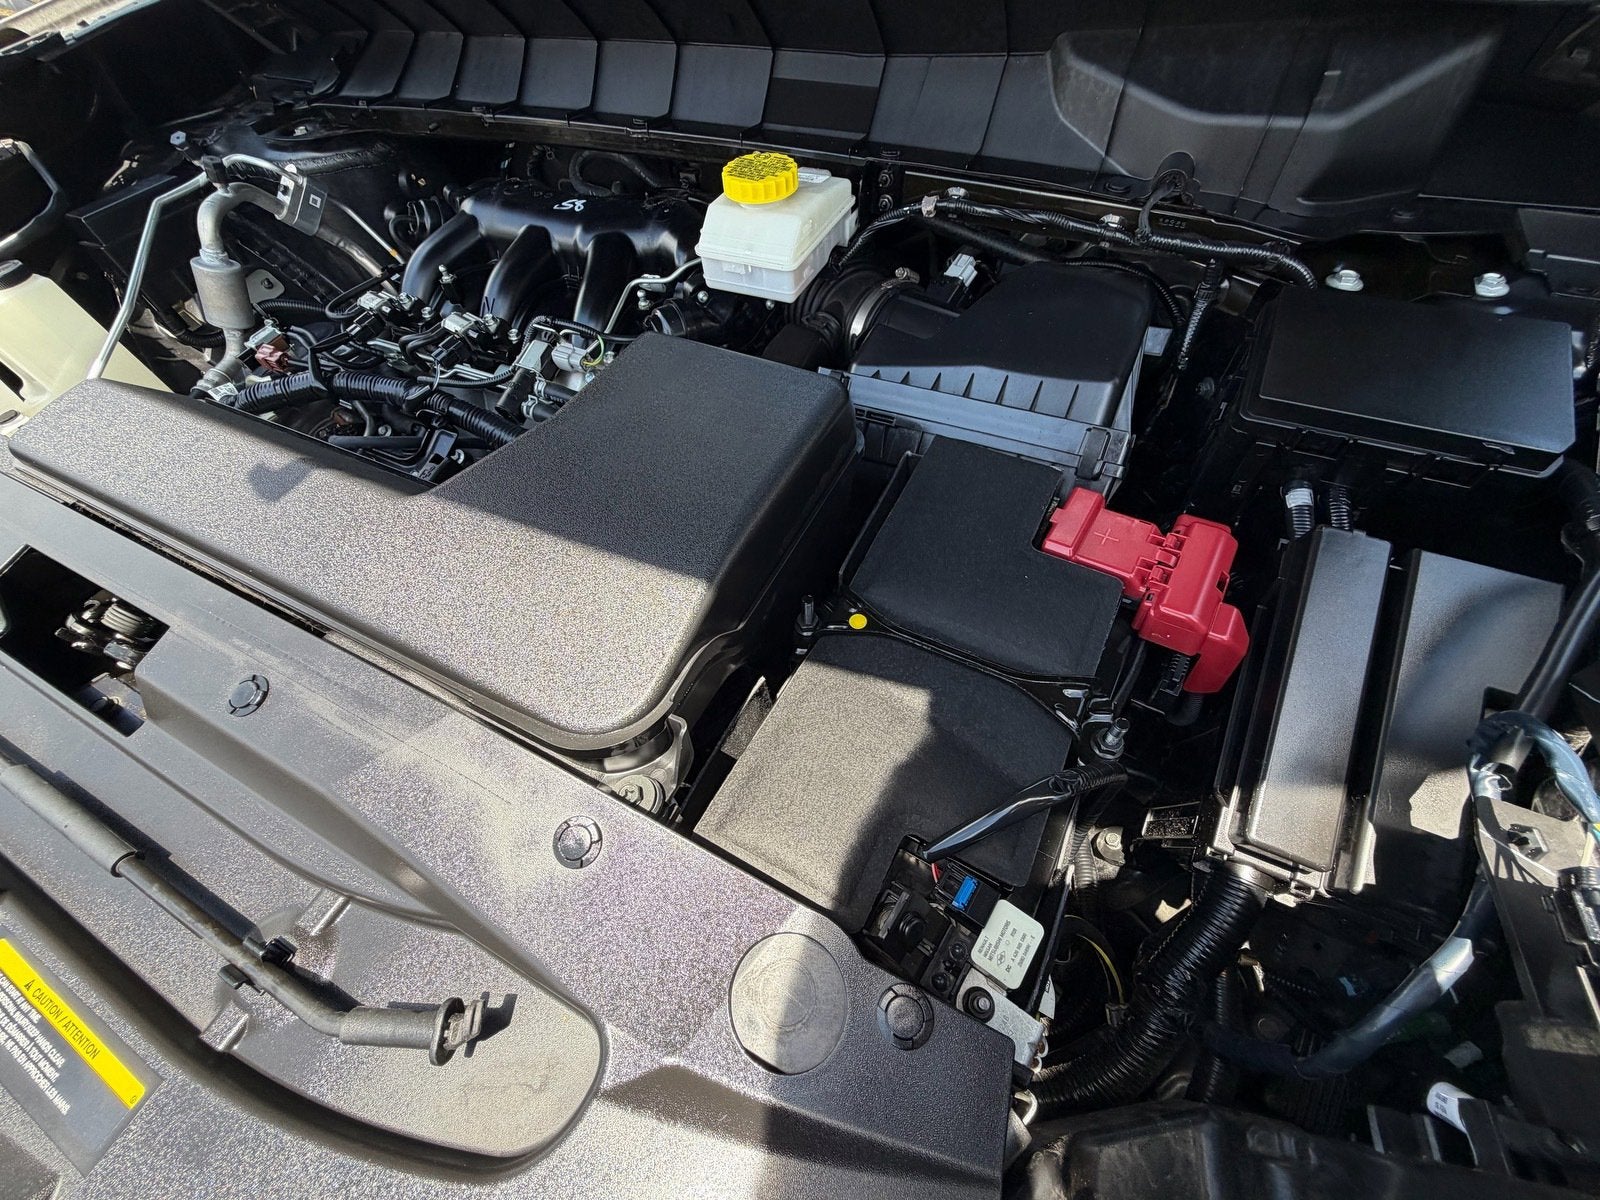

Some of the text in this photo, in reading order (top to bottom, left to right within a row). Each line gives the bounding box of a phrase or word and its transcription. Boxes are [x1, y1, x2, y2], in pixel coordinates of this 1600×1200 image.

[19, 1001, 32, 1013] ANY
[32, 988, 64, 1019] CAUTION
[63, 1020, 101, 1060] ATTENTION
[34, 1033, 53, 1053] HANDS
[28, 1046, 43, 1063] TOUT
[9, 1045, 22, 1058] PAS
[22, 1060, 51, 1092] APPROCHER
[44, 1085, 58, 1100] LES
